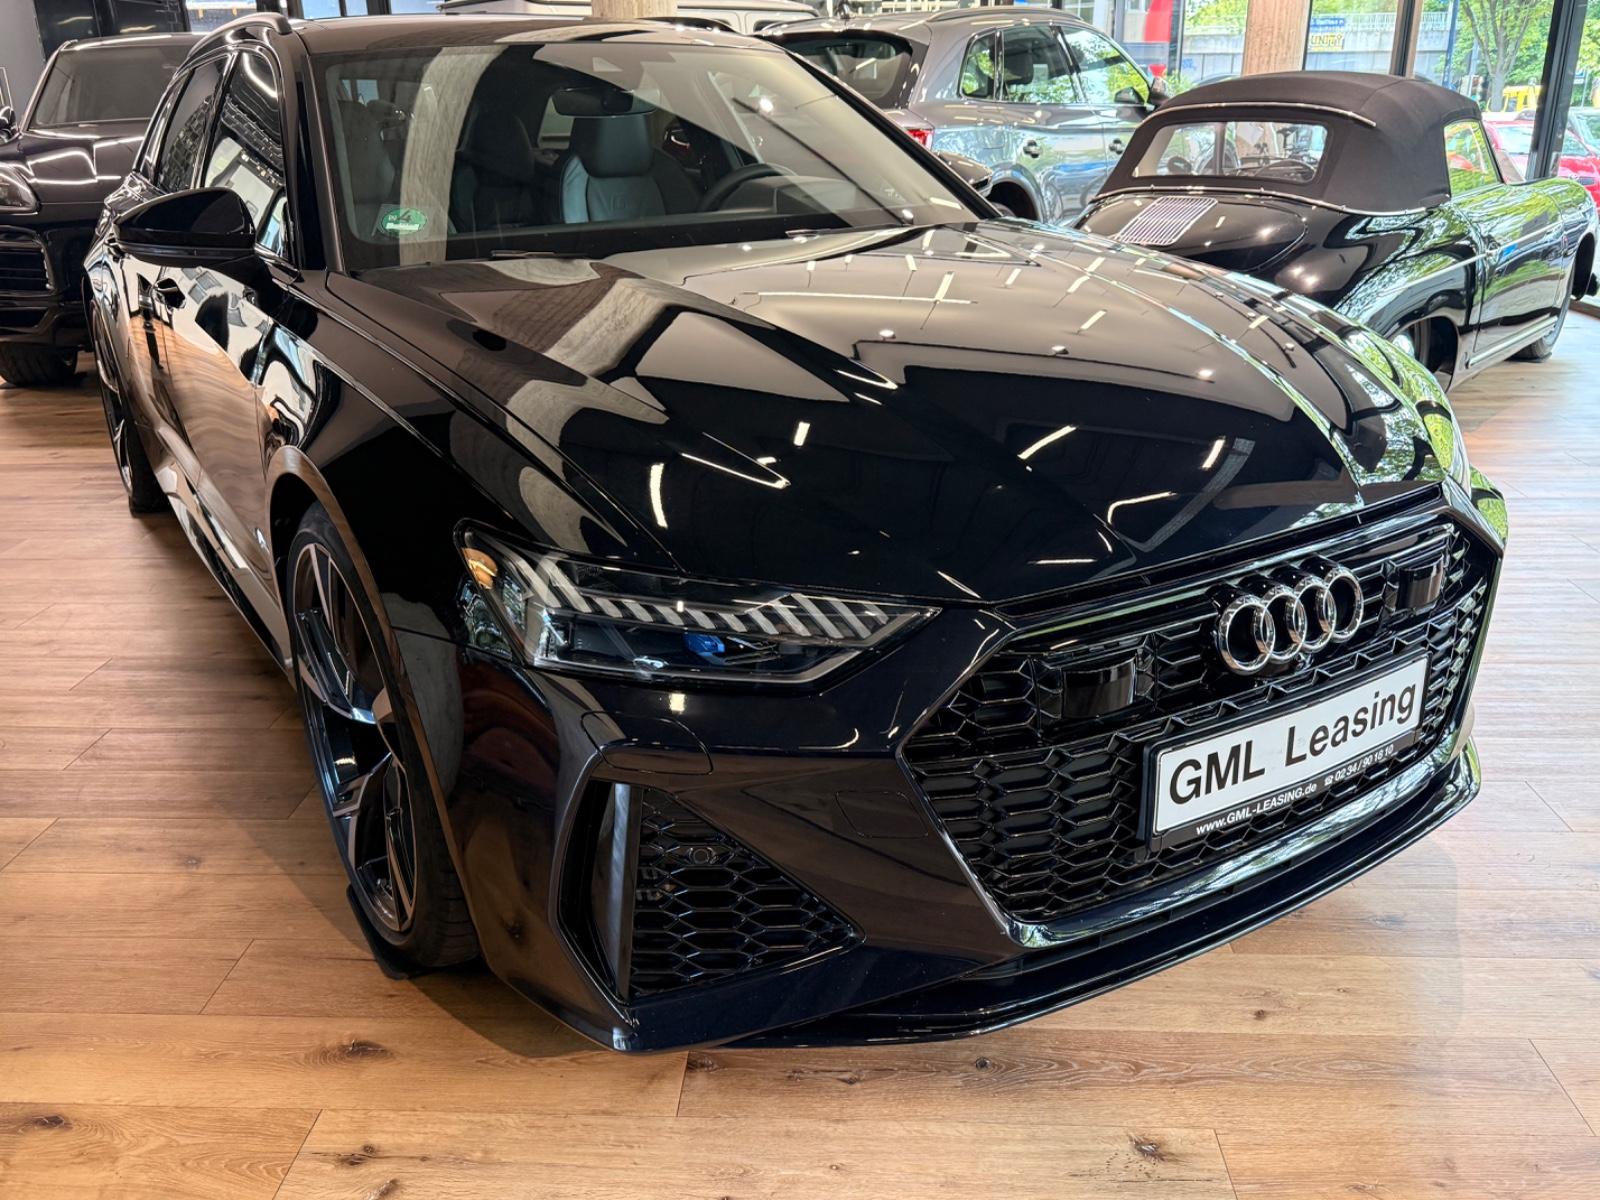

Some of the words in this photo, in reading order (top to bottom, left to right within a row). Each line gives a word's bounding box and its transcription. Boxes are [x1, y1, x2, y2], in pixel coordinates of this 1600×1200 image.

[1169, 740, 1266, 805] GML
[1285, 683, 1417, 765] Leasing
[1195, 782, 1318, 836] www.GML-LEASING.de
